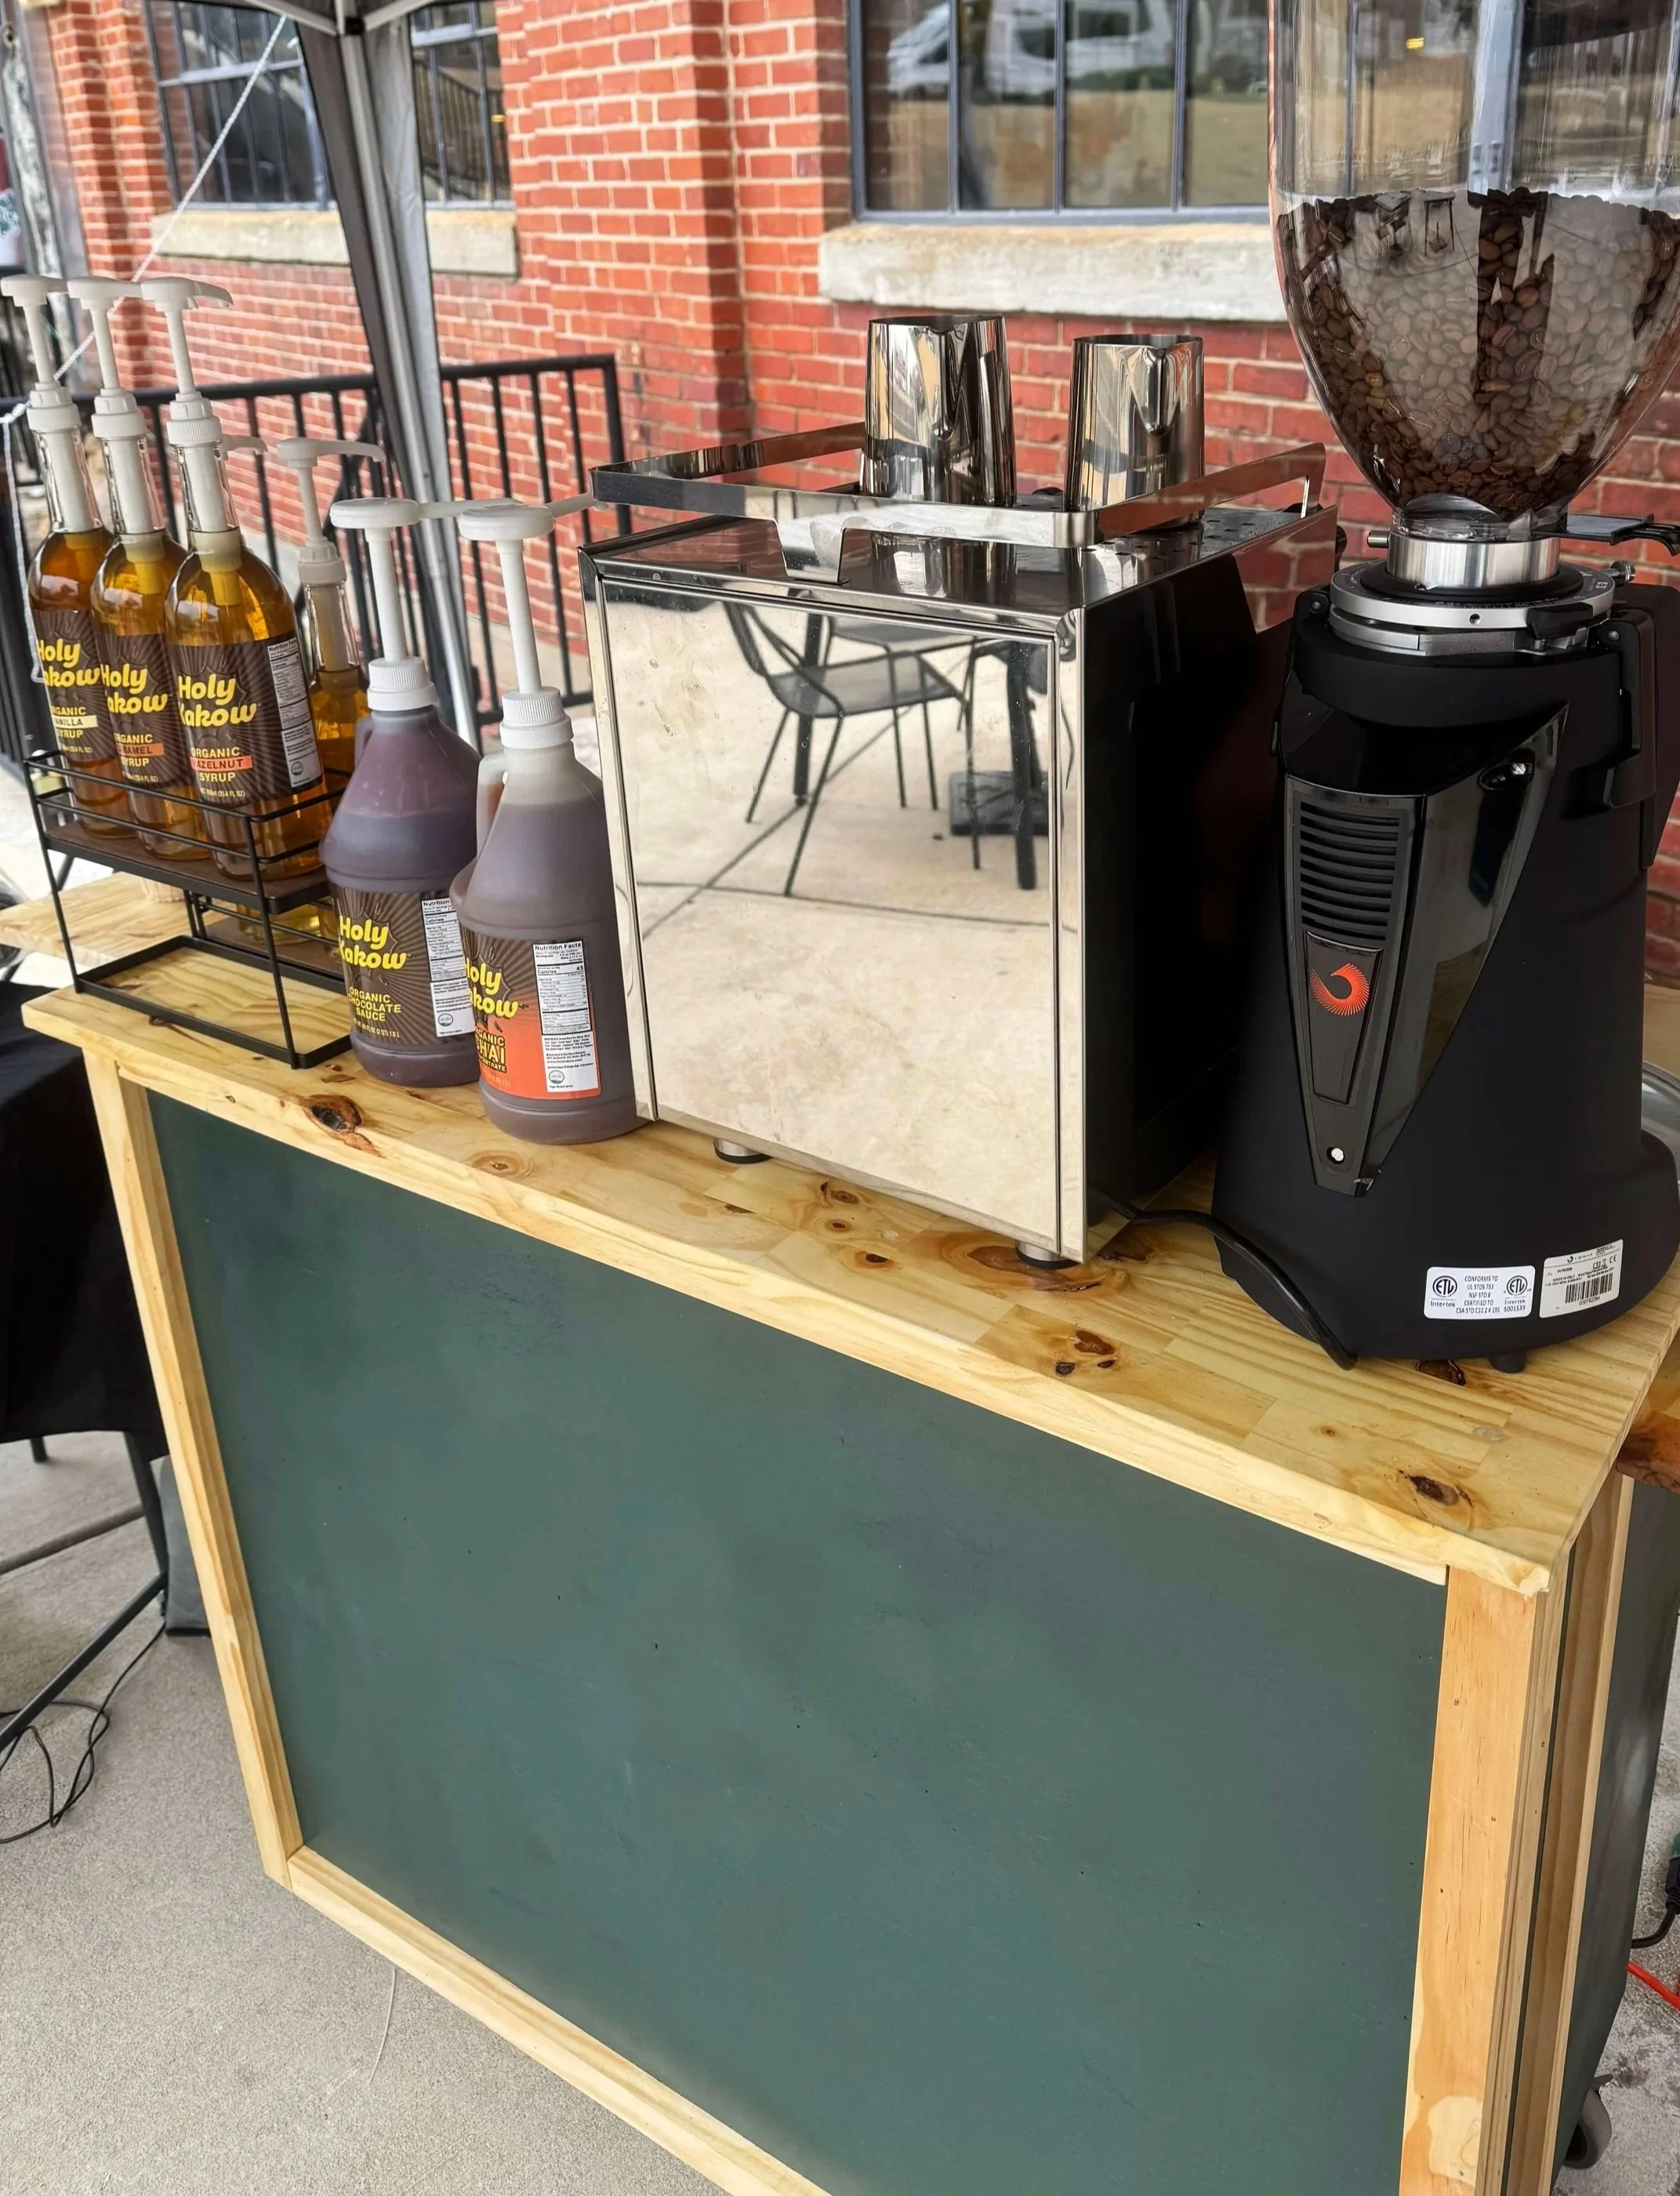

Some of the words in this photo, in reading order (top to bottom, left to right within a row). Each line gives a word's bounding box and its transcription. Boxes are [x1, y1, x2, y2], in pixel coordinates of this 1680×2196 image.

[38, 638, 81, 669] Holy
[44, 666, 101, 688] akow
[100, 663, 147, 694] Holy
[178, 673, 237, 705] Holy
[107, 691, 169, 713] akow
[191, 746, 240, 758] ORGANIC
[194, 758, 244, 769] AZELNUT
[199, 772, 235, 782] SYRUP
[339, 915, 389, 950] Holy
[350, 987, 390, 1003] ORGANIC
[470, 986, 518, 1018] kow
[356, 1007, 385, 1022] SAUCE
